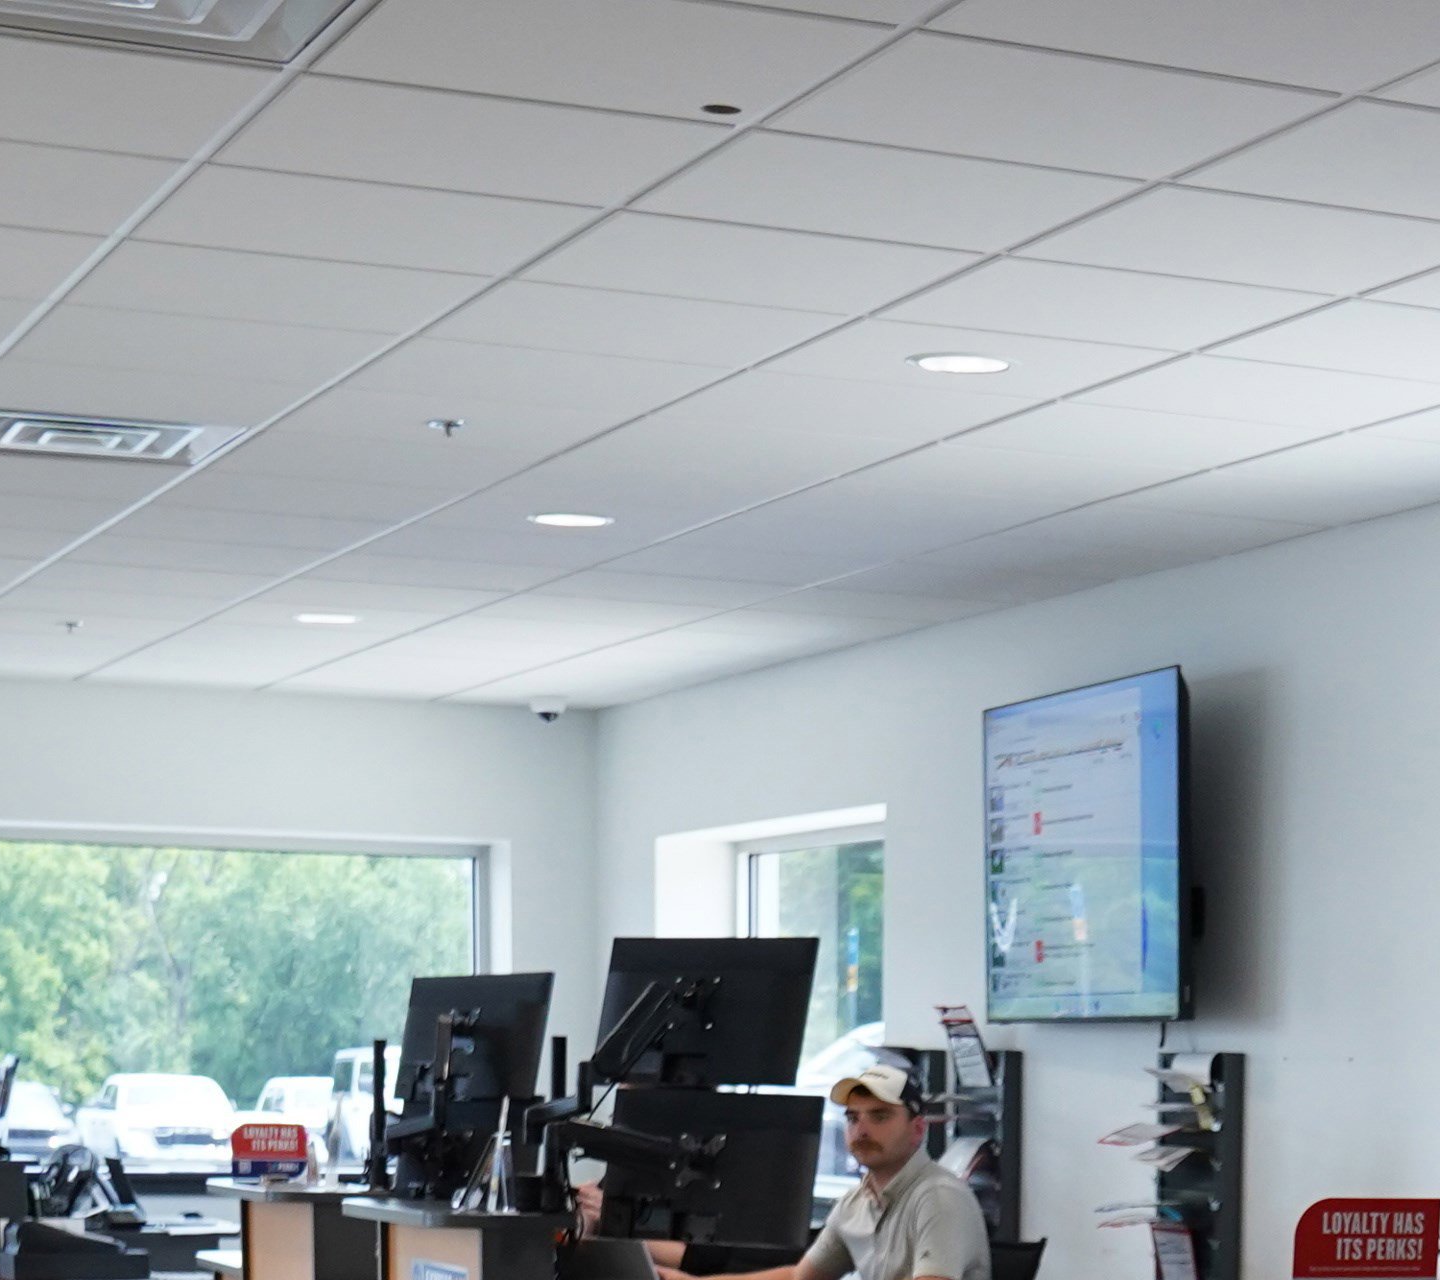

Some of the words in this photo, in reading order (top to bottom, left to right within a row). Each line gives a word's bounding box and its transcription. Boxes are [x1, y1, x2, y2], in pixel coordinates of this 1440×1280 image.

[243, 1127, 280, 1140] LOYALTY
[281, 1127, 298, 1139] HAS
[1322, 1211, 1391, 1235] LOYALTY
[1393, 1211, 1426, 1235] HAS
[1336, 1237, 1364, 1261] ITS
[1366, 1237, 1424, 1261] PERKS!
